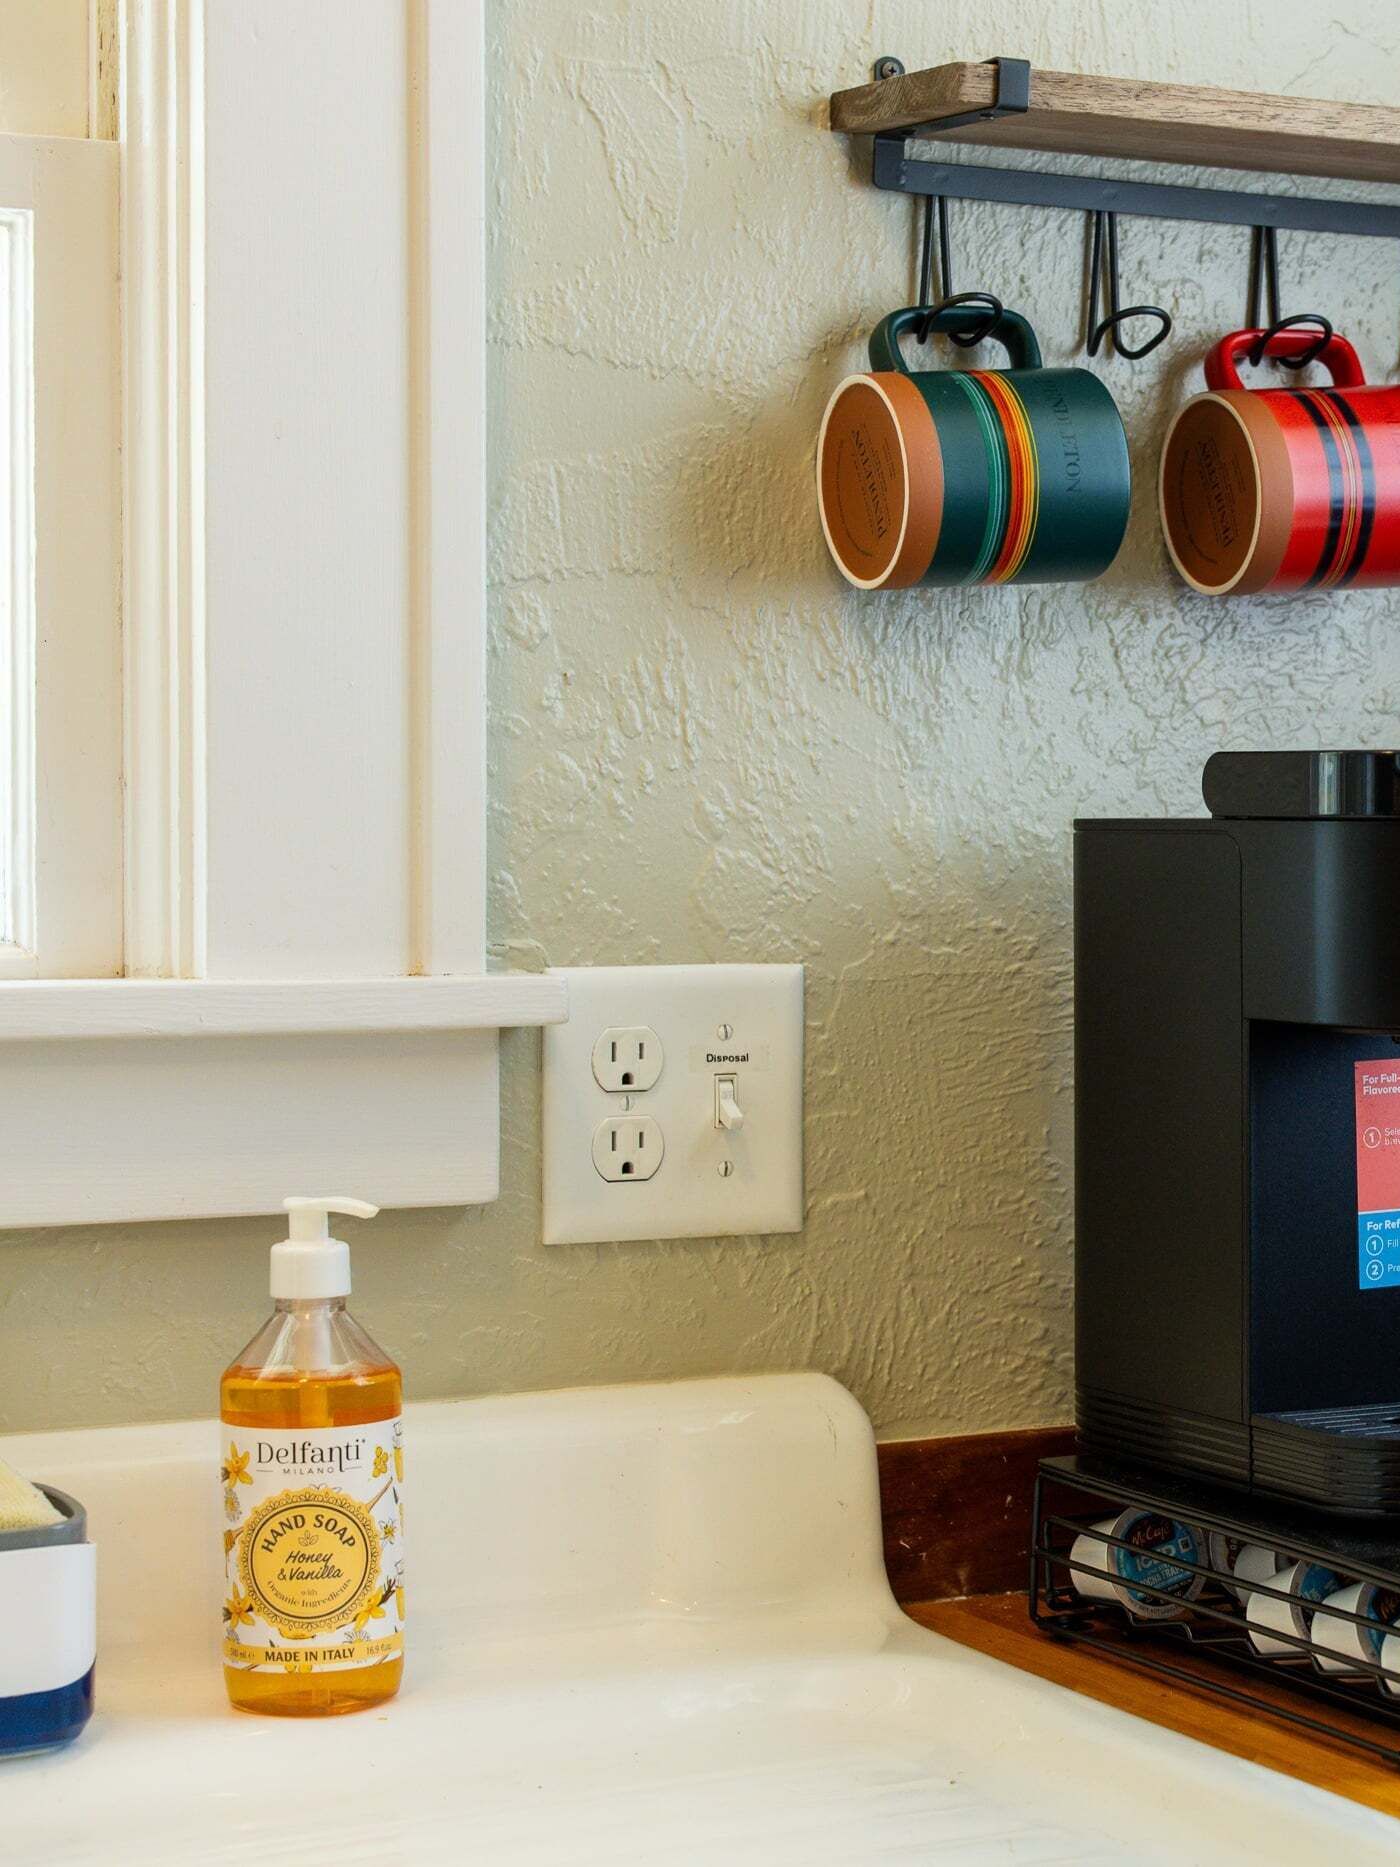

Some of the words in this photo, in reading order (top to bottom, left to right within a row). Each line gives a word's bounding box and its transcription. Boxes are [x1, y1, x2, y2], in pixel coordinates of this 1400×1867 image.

[706, 1052, 749, 1063] Disposal
[1362, 1075, 1379, 1085] For
[1380, 1073, 1400, 1084] Full-
[1366, 1221, 1383, 1231] For
[1387, 1238, 1399, 1249] Fill
[257, 1439, 360, 1472] Delfanti
[283, 1467, 335, 1475] MILANO
[261, 1514, 306, 1553] HAND
[313, 1514, 356, 1548] SOAP
[285, 1550, 333, 1567] Honey
[289, 1564, 344, 1581] Vanilla
[265, 1651, 300, 1662] MADE
[305, 1651, 318, 1662] IN
[323, 1648, 355, 1660] ITALY
